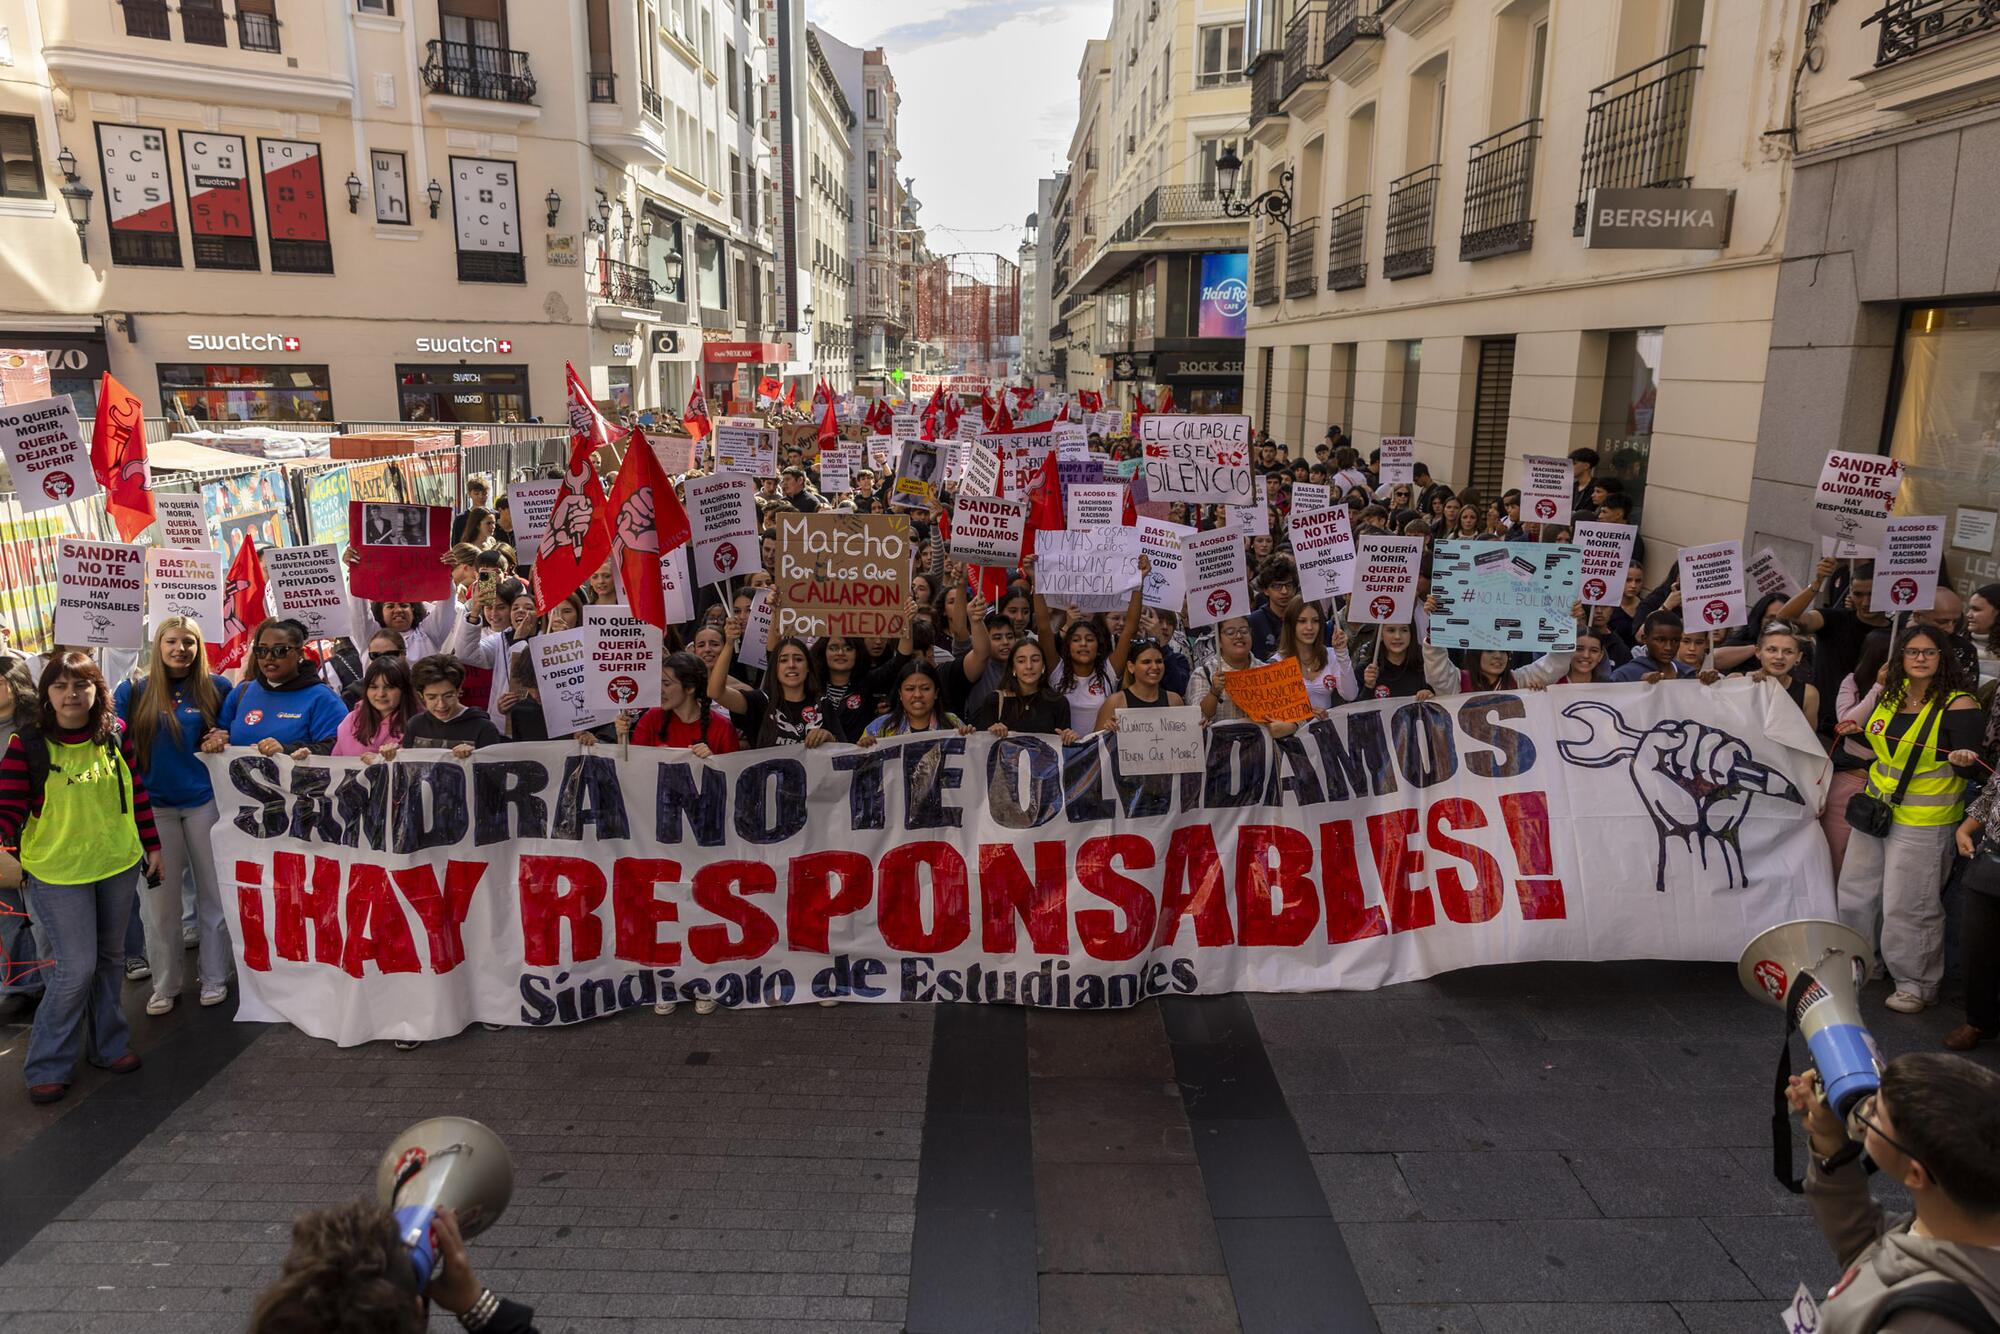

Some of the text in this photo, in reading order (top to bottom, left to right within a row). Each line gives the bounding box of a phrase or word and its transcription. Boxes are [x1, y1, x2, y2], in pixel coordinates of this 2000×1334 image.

[1598, 209, 1714, 227] BERSHKA
[1203, 286, 1230, 300] Hard
[187, 333, 282, 350] swatch
[416, 336, 498, 354] swatch
[1180, 362, 1218, 372] ROCK
[0, 405, 70, 428] NO QUERÍA
[16, 420, 63, 437] MORIR,
[1144, 420, 1170, 441] EL
[1173, 420, 1244, 442] CULPABLE
[18, 430, 68, 450] QUERÍA
[1011, 436, 1052, 448] SE HACE
[16, 441, 78, 463] DEJAR DE
[1173, 444, 1216, 460] ES EL
[26, 454, 74, 472] SUFRIR
[1829, 456, 1897, 477] SANDRA
[1146, 462, 1250, 496] SILENCIO
[1838, 472, 1881, 488] NO TE
[692, 480, 746, 496] EL ACOSO ES:
[1822, 482, 1891, 500] OLVIDAMOS
[700, 492, 740, 506] MACHISMO
[1843, 498, 1862, 507] HAY
[700, 502, 742, 515] LGTBIFOBIA
[958, 499, 1021, 518] SANDRA
[1816, 502, 1888, 519] RESPONSABLES
[705, 510, 738, 523] RACISMO
[969, 514, 1008, 528] NO TE
[1292, 509, 1346, 529] SANDRA
[704, 518, 741, 532] FASCISMO
[1304, 524, 1337, 539] NO TE
[783, 516, 903, 559] Marcho
[956, 525, 1019, 542] OLVIDAMOS
[1145, 526, 1176, 540] BASTA
[1200, 536, 1225, 546] ACOSO
[1226, 534, 1238, 542] ES:
[1579, 529, 1631, 542] NO QUERÍA
[978, 540, 994, 549] HAY
[1037, 530, 1053, 551] NO
[1296, 533, 1350, 551] OLVIDAMOS
[1586, 539, 1621, 550] MORIR,
[64, 544, 140, 564] SANDRA
[275, 549, 328, 562] BASTA DE
[953, 547, 1017, 558] RESPONSABLES
[1195, 545, 1234, 559] MACHISMO
[1318, 549, 1332, 558] HAY
[1379, 544, 1418, 554] QUERÍA
[1584, 549, 1620, 560] QUERÍA
[160, 559, 197, 569] BASTA
[1195, 552, 1235, 566] LGTBIFOBIA
[1300, 553, 1354, 571] RESPONSABLES
[1371, 555, 1408, 563] MORIR,
[1685, 551, 1722, 563] EL ACOSO
[78, 561, 126, 576] NO TE
[271, 559, 336, 570] SUBVENCIONES
[782, 554, 897, 581] Por Los Que
[1059, 555, 1113, 574] BULLYING
[1122, 557, 1137, 575] ES
[1200, 561, 1232, 573] RACISMO
[1368, 564, 1408, 574] QUERÍA
[1610, 561, 1623, 569] DE
[1692, 559, 1730, 570] MACHISMO
[156, 569, 214, 579] BULLYING
[288, 567, 328, 577] COLEGIOS
[1199, 567, 1234, 581] FASCISMO
[1362, 574, 1411, 584] DEJAR DE
[1581, 567, 1616, 577] SUFRIR
[1692, 566, 1732, 578] LGTBIFOBIA
[1697, 574, 1729, 583] RACISMO
[62, 574, 140, 590] OLVIDAMOS
[161, 582, 217, 590] DISCURSOS
[278, 575, 336, 588] PRIVADOS
[1042, 574, 1113, 593] VIOLENCIA
[1366, 584, 1404, 592] SUFRIR
[1695, 579, 1732, 591] FASCISMO
[90, 590, 110, 600] HAY
[177, 592, 206, 600] ODIO
[284, 590, 322, 599] BASTA
[788, 582, 900, 608] CALLARON
[60, 598, 140, 612] RESPONSABLES
[283, 597, 340, 610] BULLYING
[588, 616, 606, 625] NO
[779, 608, 904, 636] Por MIEDO
[600, 628, 645, 638] MORIR,
[543, 640, 584, 655] BASTA
[598, 639, 647, 650] QUERÍA
[592, 651, 653, 661] DEJAR DE
[599, 662, 646, 672] SUFRIR
[229, 755, 630, 854] SANDRA
[655, 757, 808, 846] NO
[832, 737, 967, 832] TE
[235, 790, 1566, 979] ¡HAY RESPONSABLES!
[520, 954, 1199, 1026] Sindicato de Estudiantes
